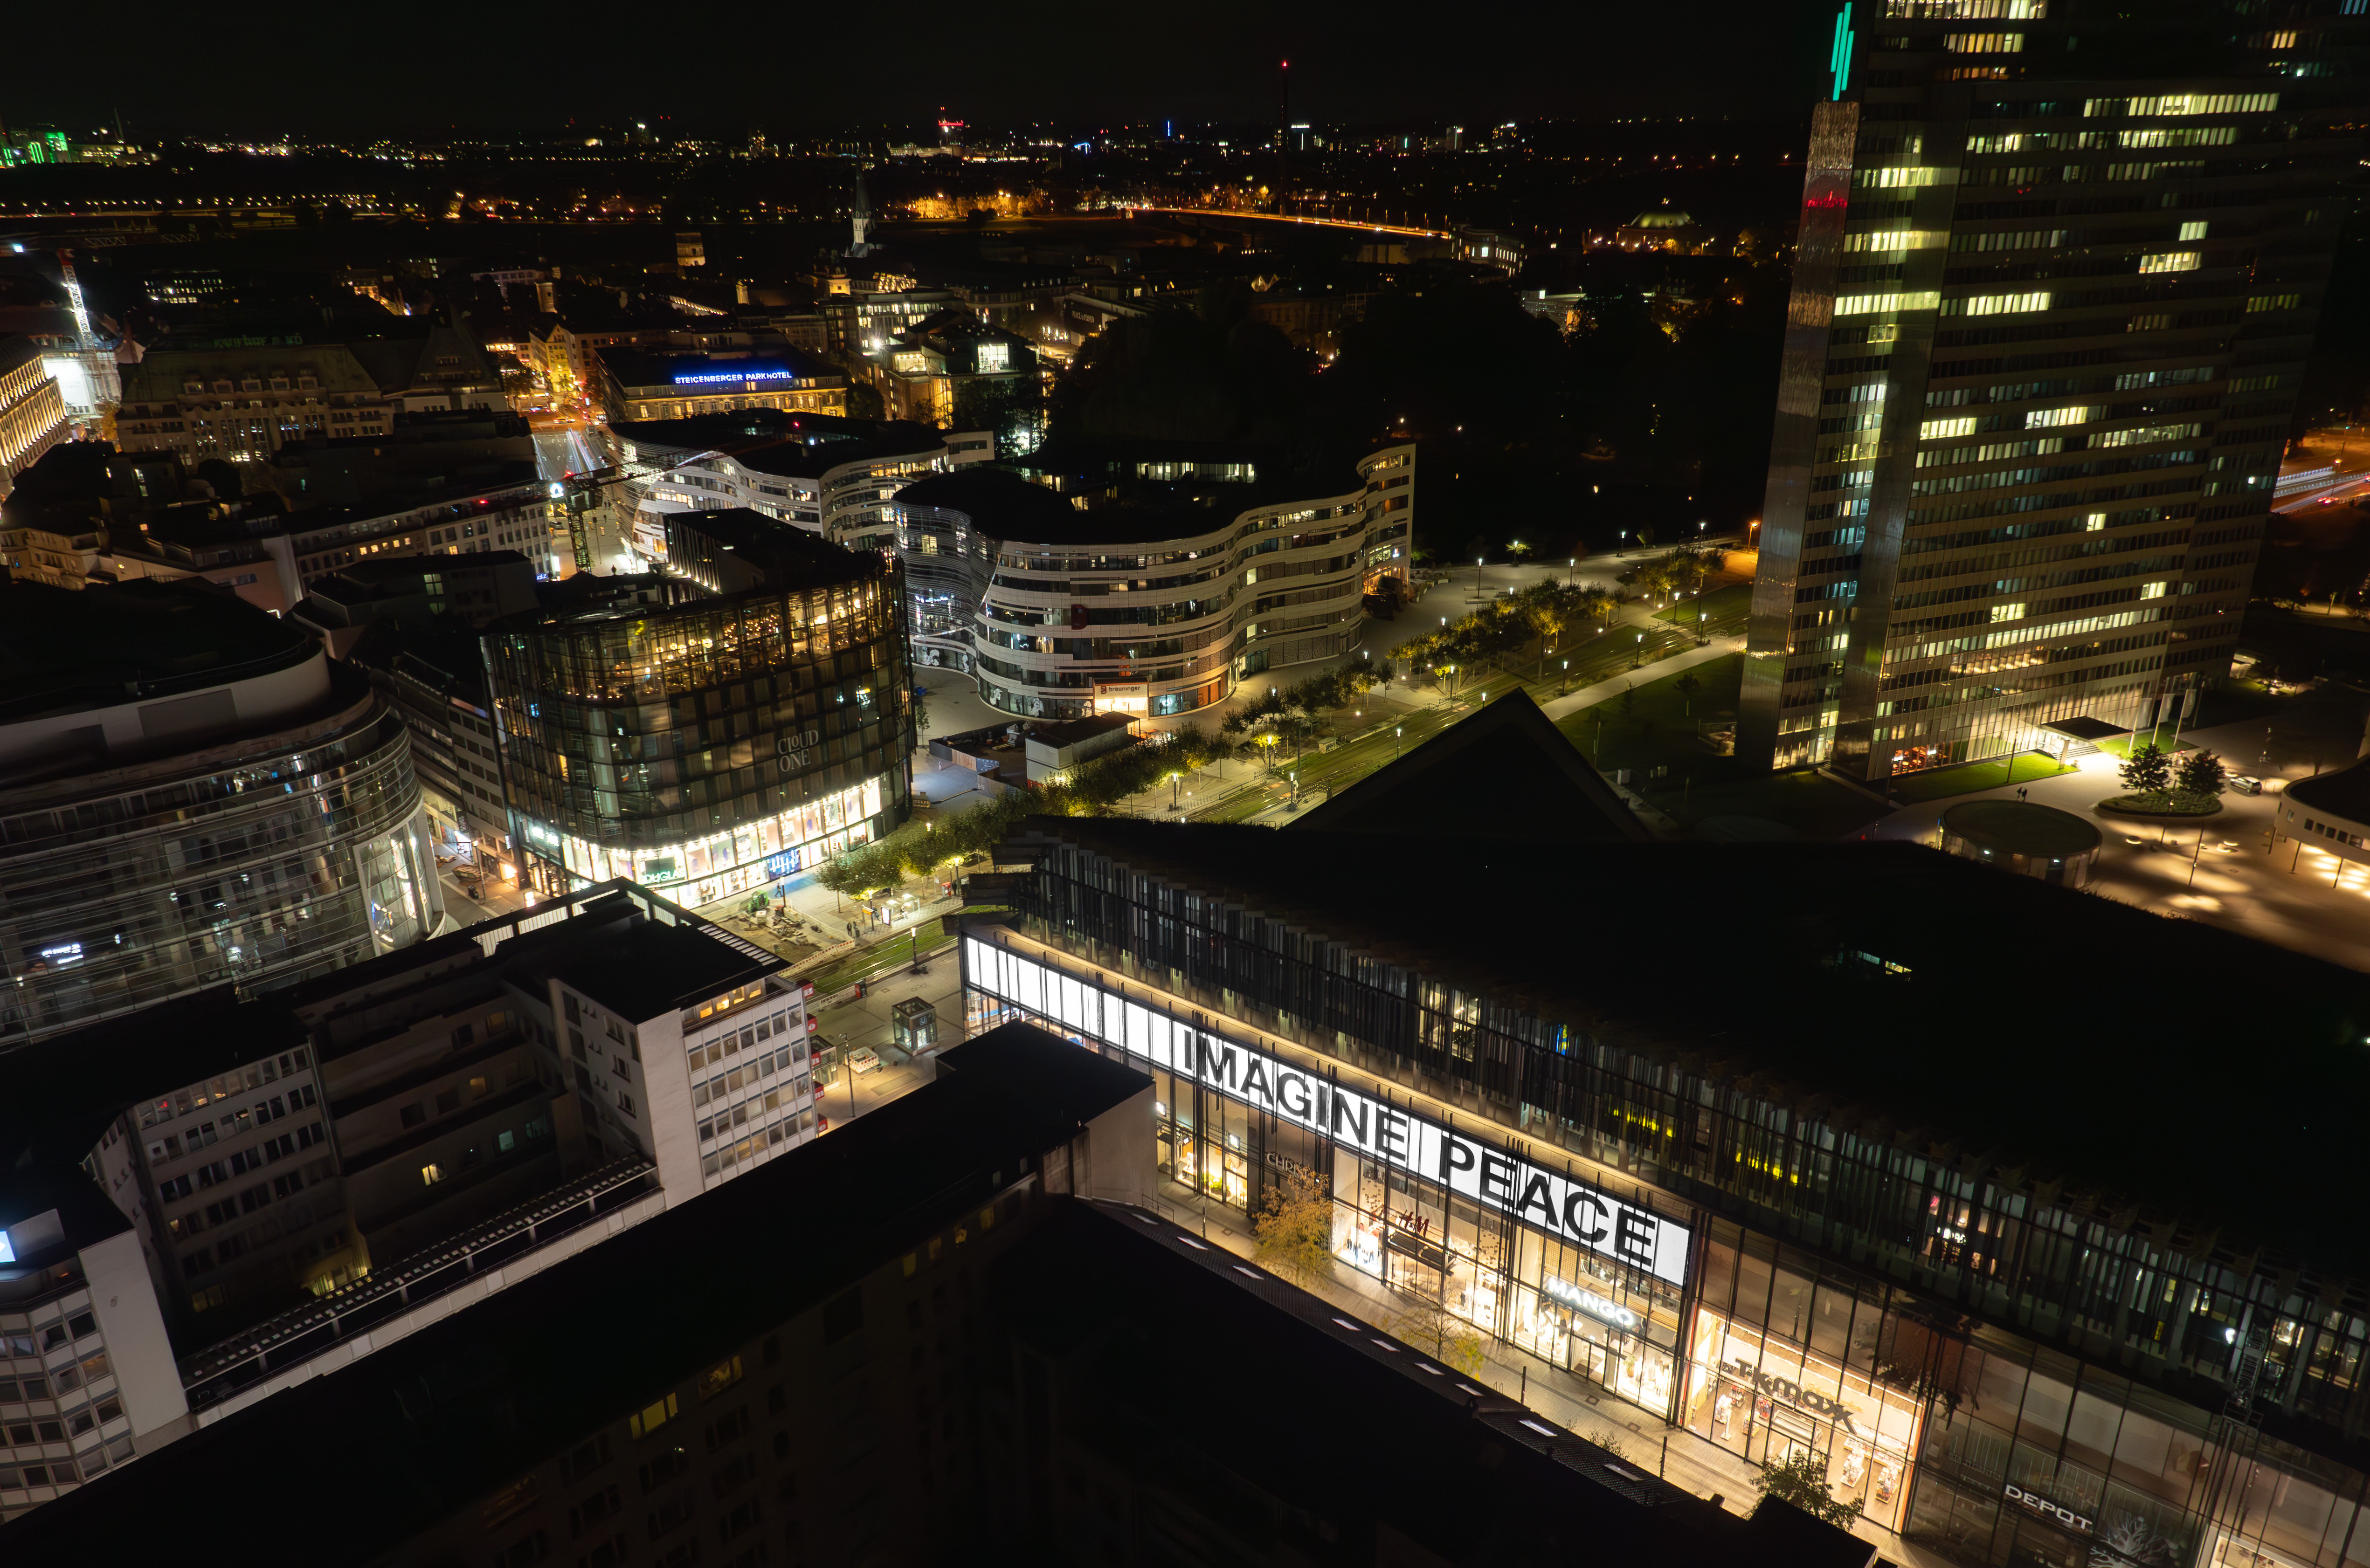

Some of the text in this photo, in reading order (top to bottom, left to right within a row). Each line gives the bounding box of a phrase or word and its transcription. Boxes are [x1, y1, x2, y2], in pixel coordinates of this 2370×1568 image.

[675, 372, 792, 385] STEIGENBERGER PARKHOTEL
[778, 730, 819, 754] CLOUD
[780, 749, 810, 772] ONE
[1184, 1029, 1656, 1267] IMAGINE PEACE
[1548, 1277, 1634, 1326] MANGO
[1768, 1366, 1804, 1387] WILLKOMMN
[2005, 1484, 2093, 1530] DEPOT
